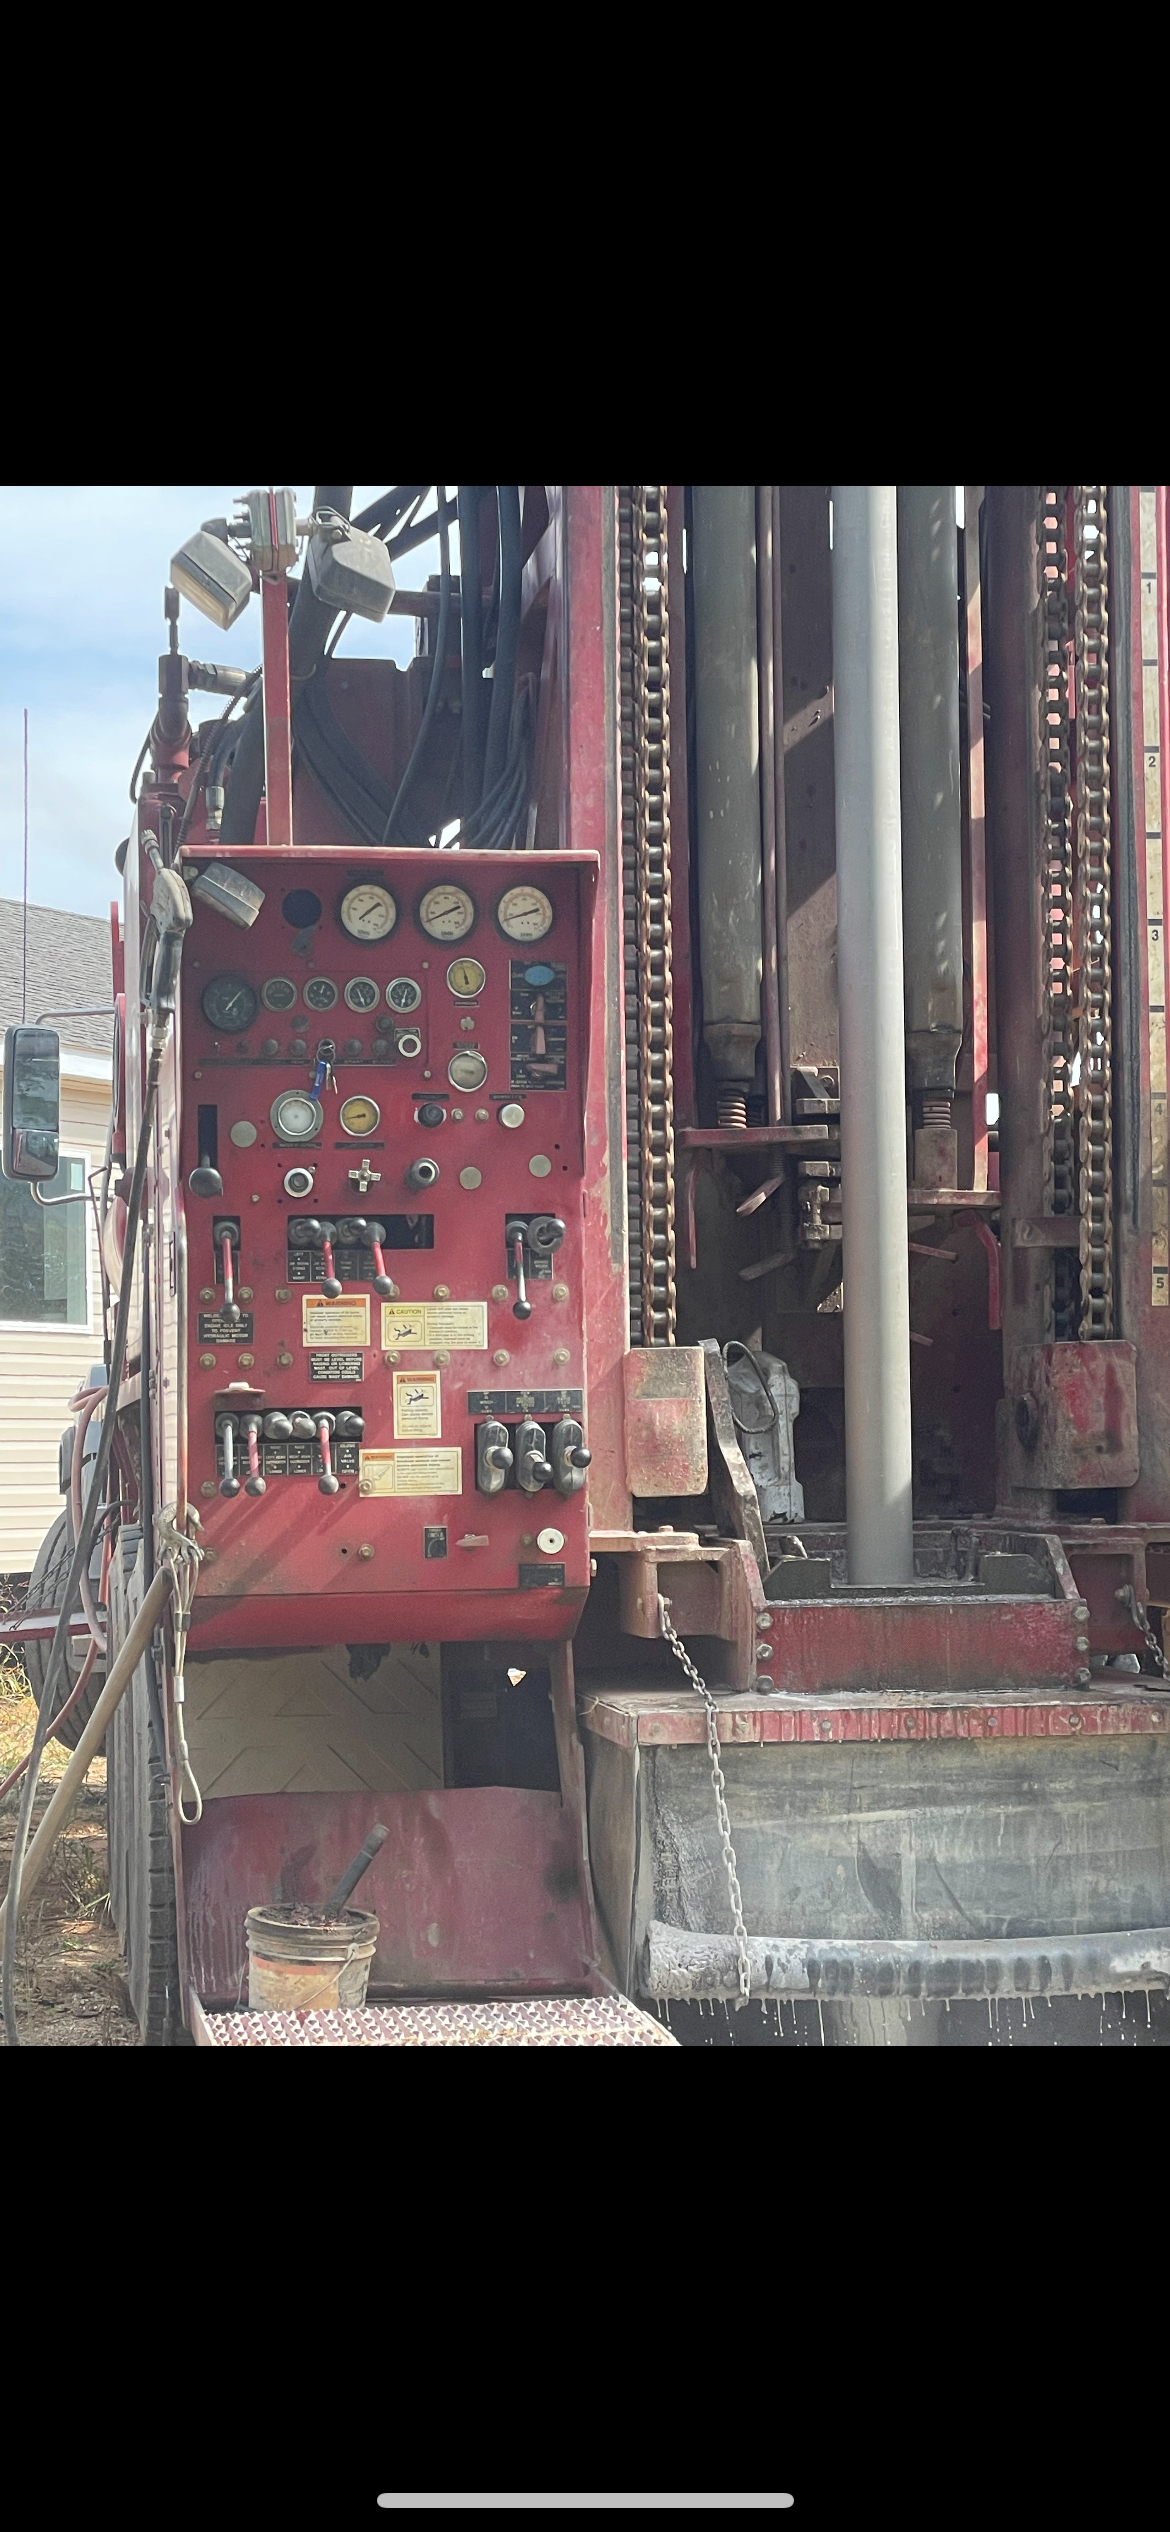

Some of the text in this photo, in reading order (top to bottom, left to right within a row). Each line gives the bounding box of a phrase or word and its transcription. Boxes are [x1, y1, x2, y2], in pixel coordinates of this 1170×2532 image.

[1146, 581, 1151, 594] 1
[1148, 755, 1156, 767] 2
[1151, 929, 1159, 941] 3
[1155, 1102, 1163, 1115] 4
[1156, 1276, 1164, 1289] 5
